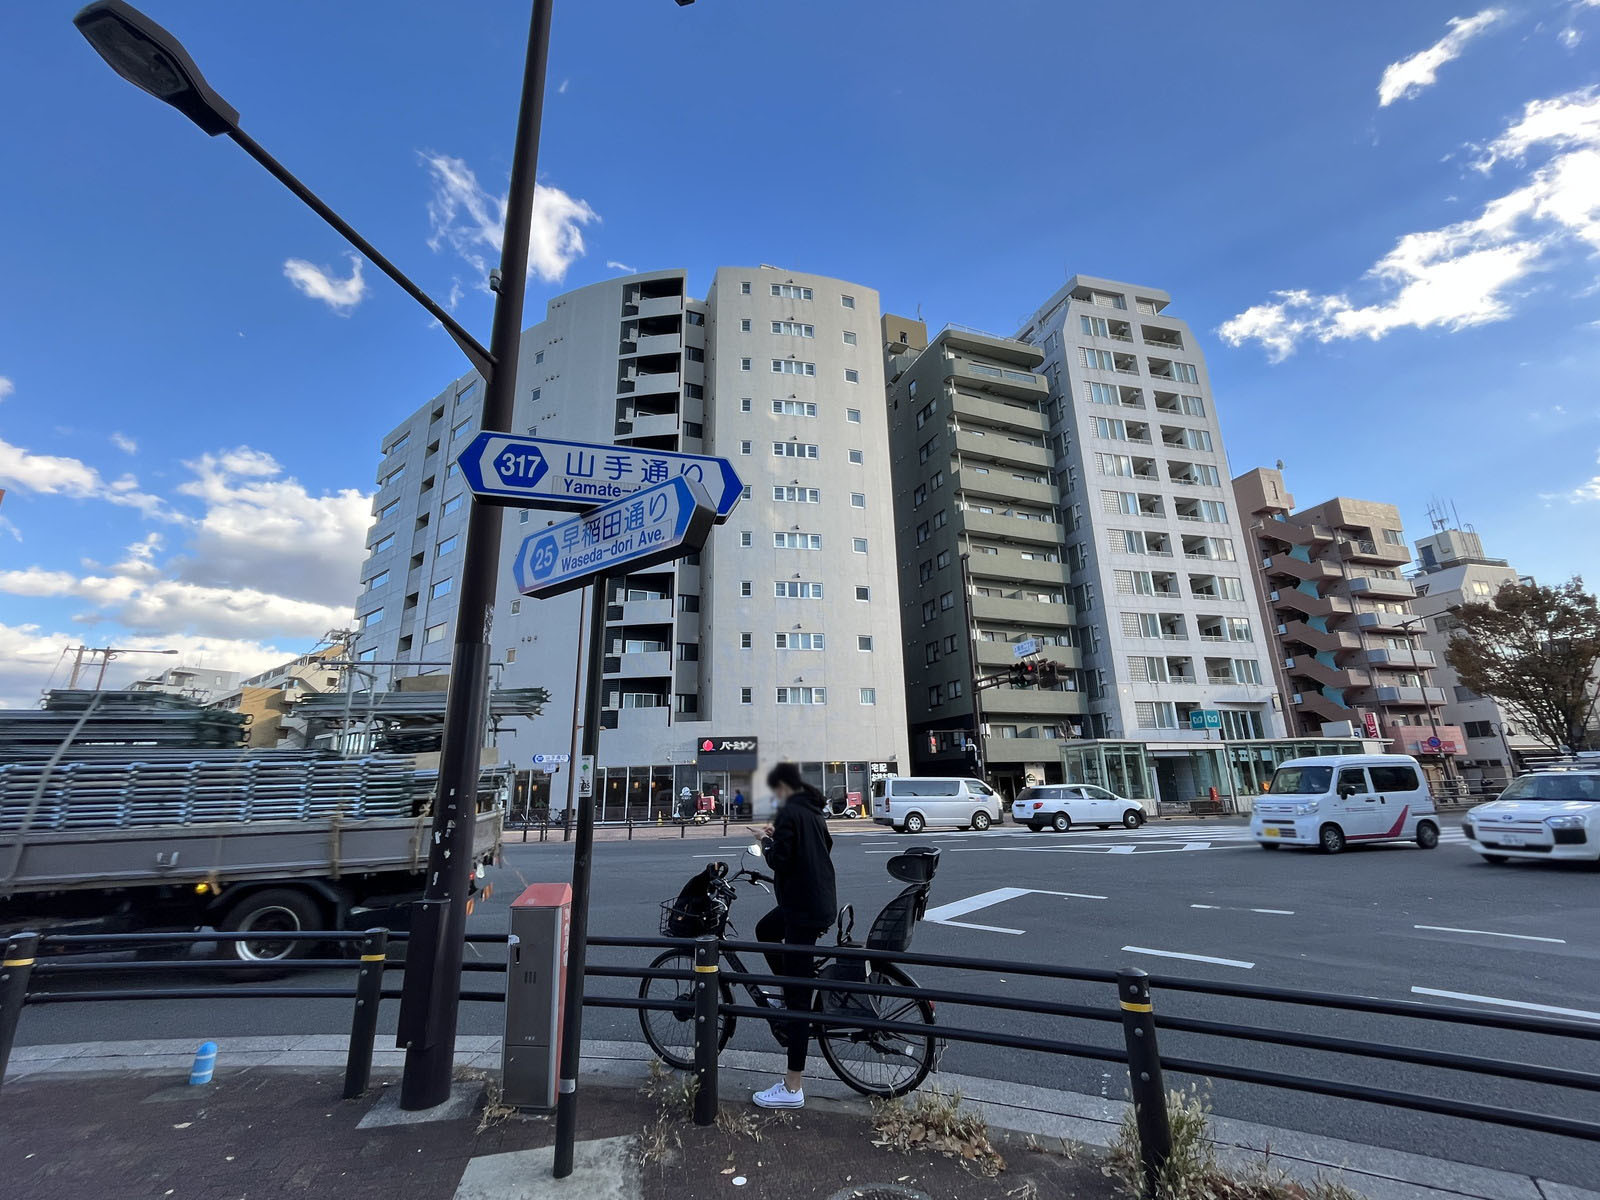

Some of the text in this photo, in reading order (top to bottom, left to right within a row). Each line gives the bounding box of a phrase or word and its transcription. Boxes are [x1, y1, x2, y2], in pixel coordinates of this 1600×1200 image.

[500, 452, 542, 478] 317
[565, 451, 704, 484] 山手通り
[561, 492, 668, 553] 早稲田通り
[534, 545, 553, 571] 25
[561, 528, 666, 573] Waseda-dori Ave.
